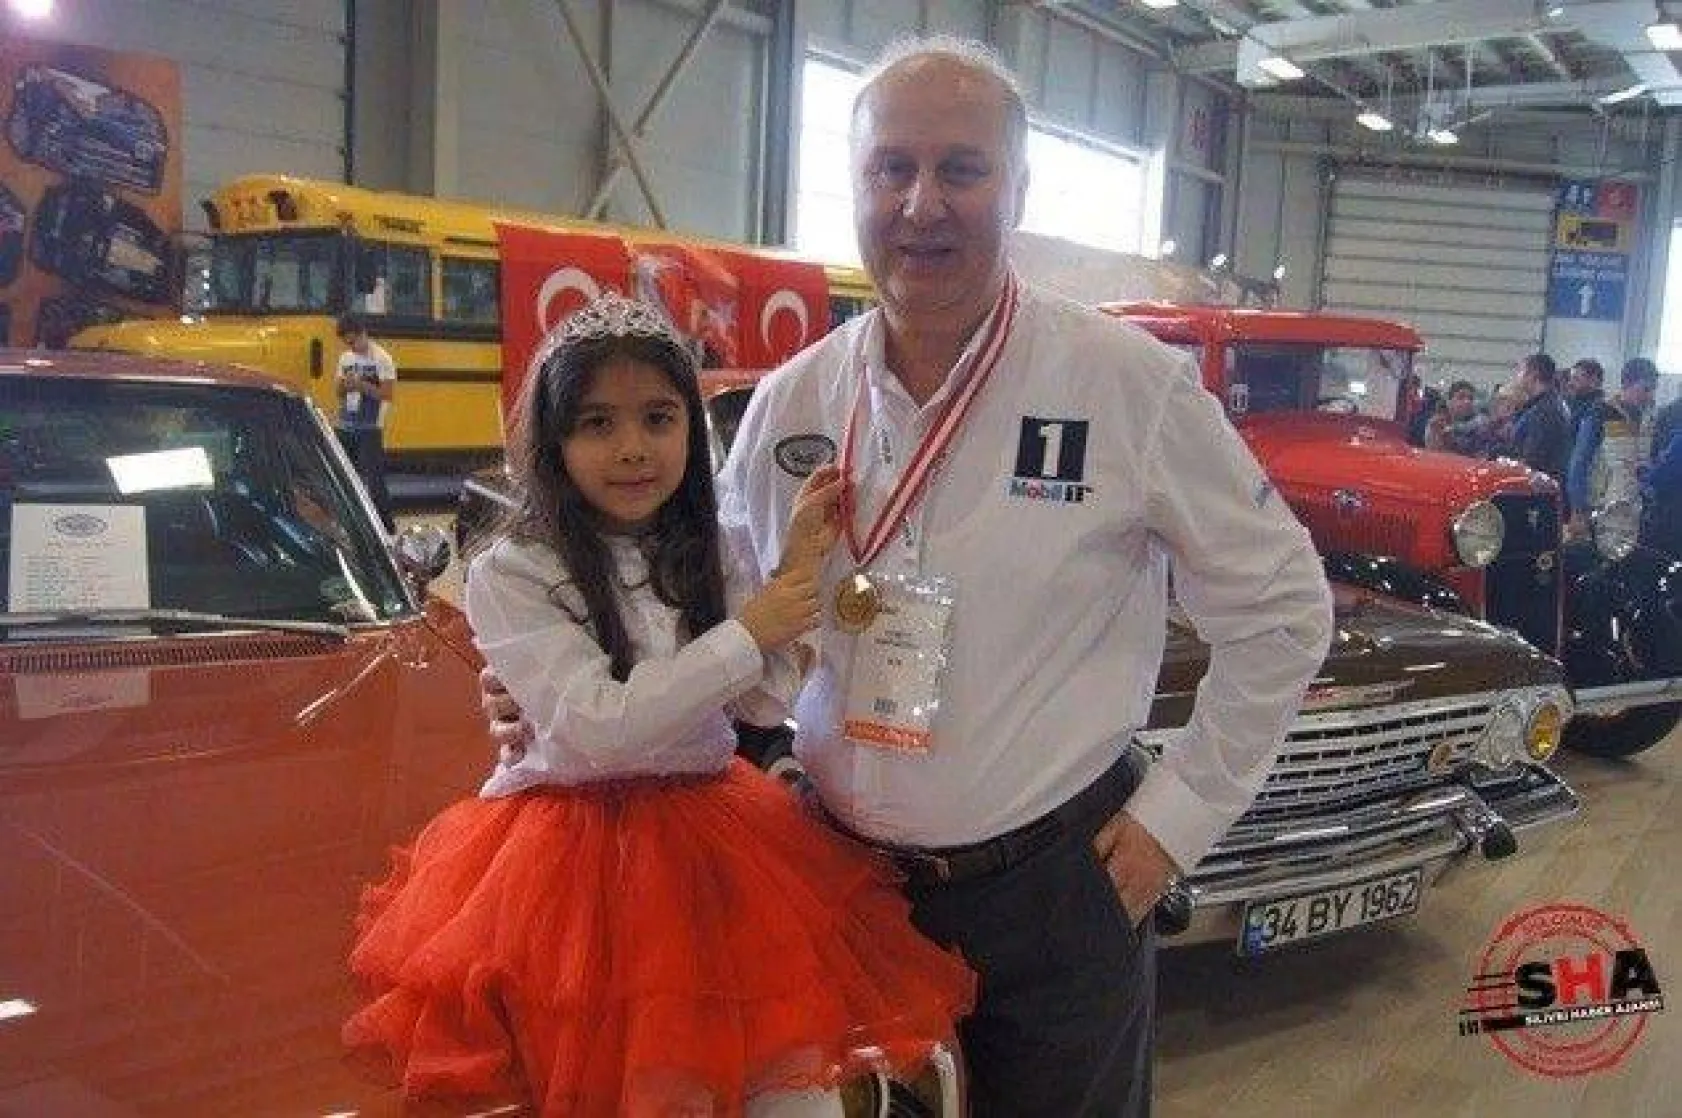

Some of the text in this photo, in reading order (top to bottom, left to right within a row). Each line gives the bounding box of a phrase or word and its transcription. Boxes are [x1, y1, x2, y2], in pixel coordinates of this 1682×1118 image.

[1039, 423, 1062, 478] 1
[1265, 902, 1298, 942] 34
[1308, 892, 1352, 933] BY
[1361, 876, 1417, 919] 1962
